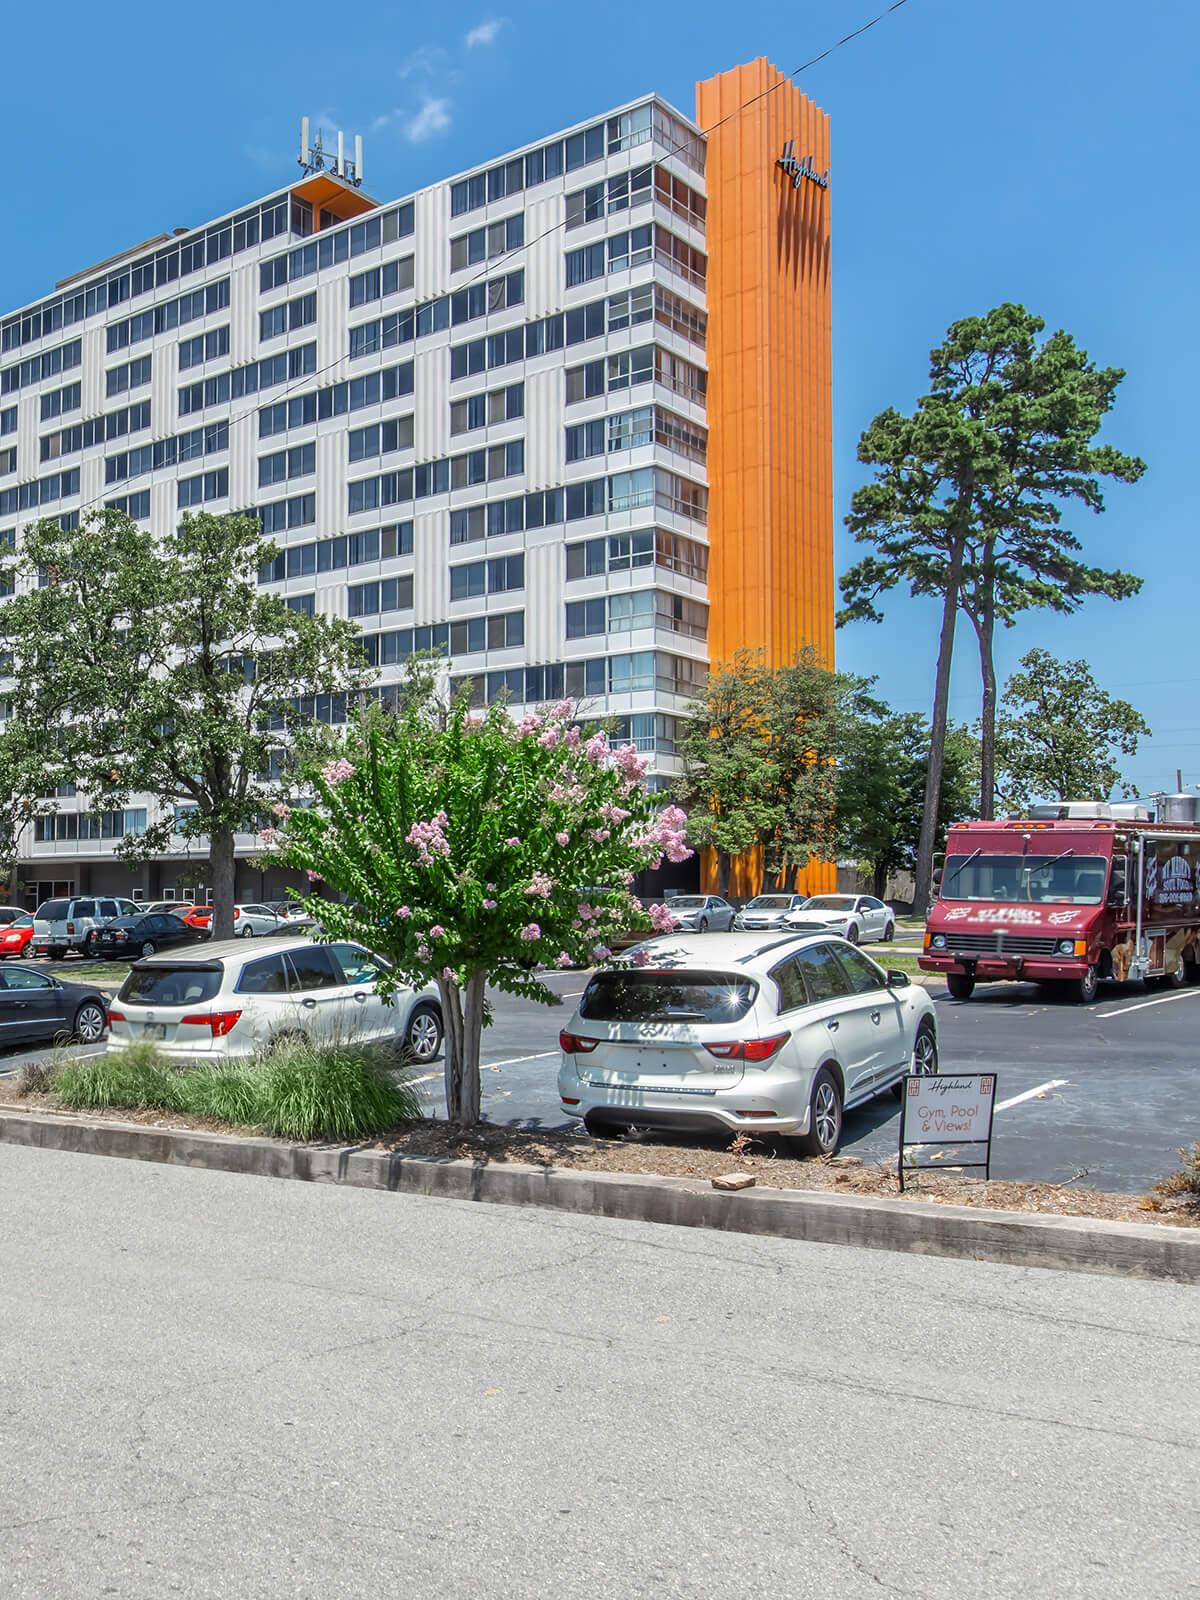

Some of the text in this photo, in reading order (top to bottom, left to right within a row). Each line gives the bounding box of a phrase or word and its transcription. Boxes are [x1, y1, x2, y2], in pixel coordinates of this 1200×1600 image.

[778, 140, 830, 189] Highland
[928, 1078, 973, 1096] Highland
[951, 1104, 978, 1117] Pool
[921, 1119, 972, 1132] & Views!
